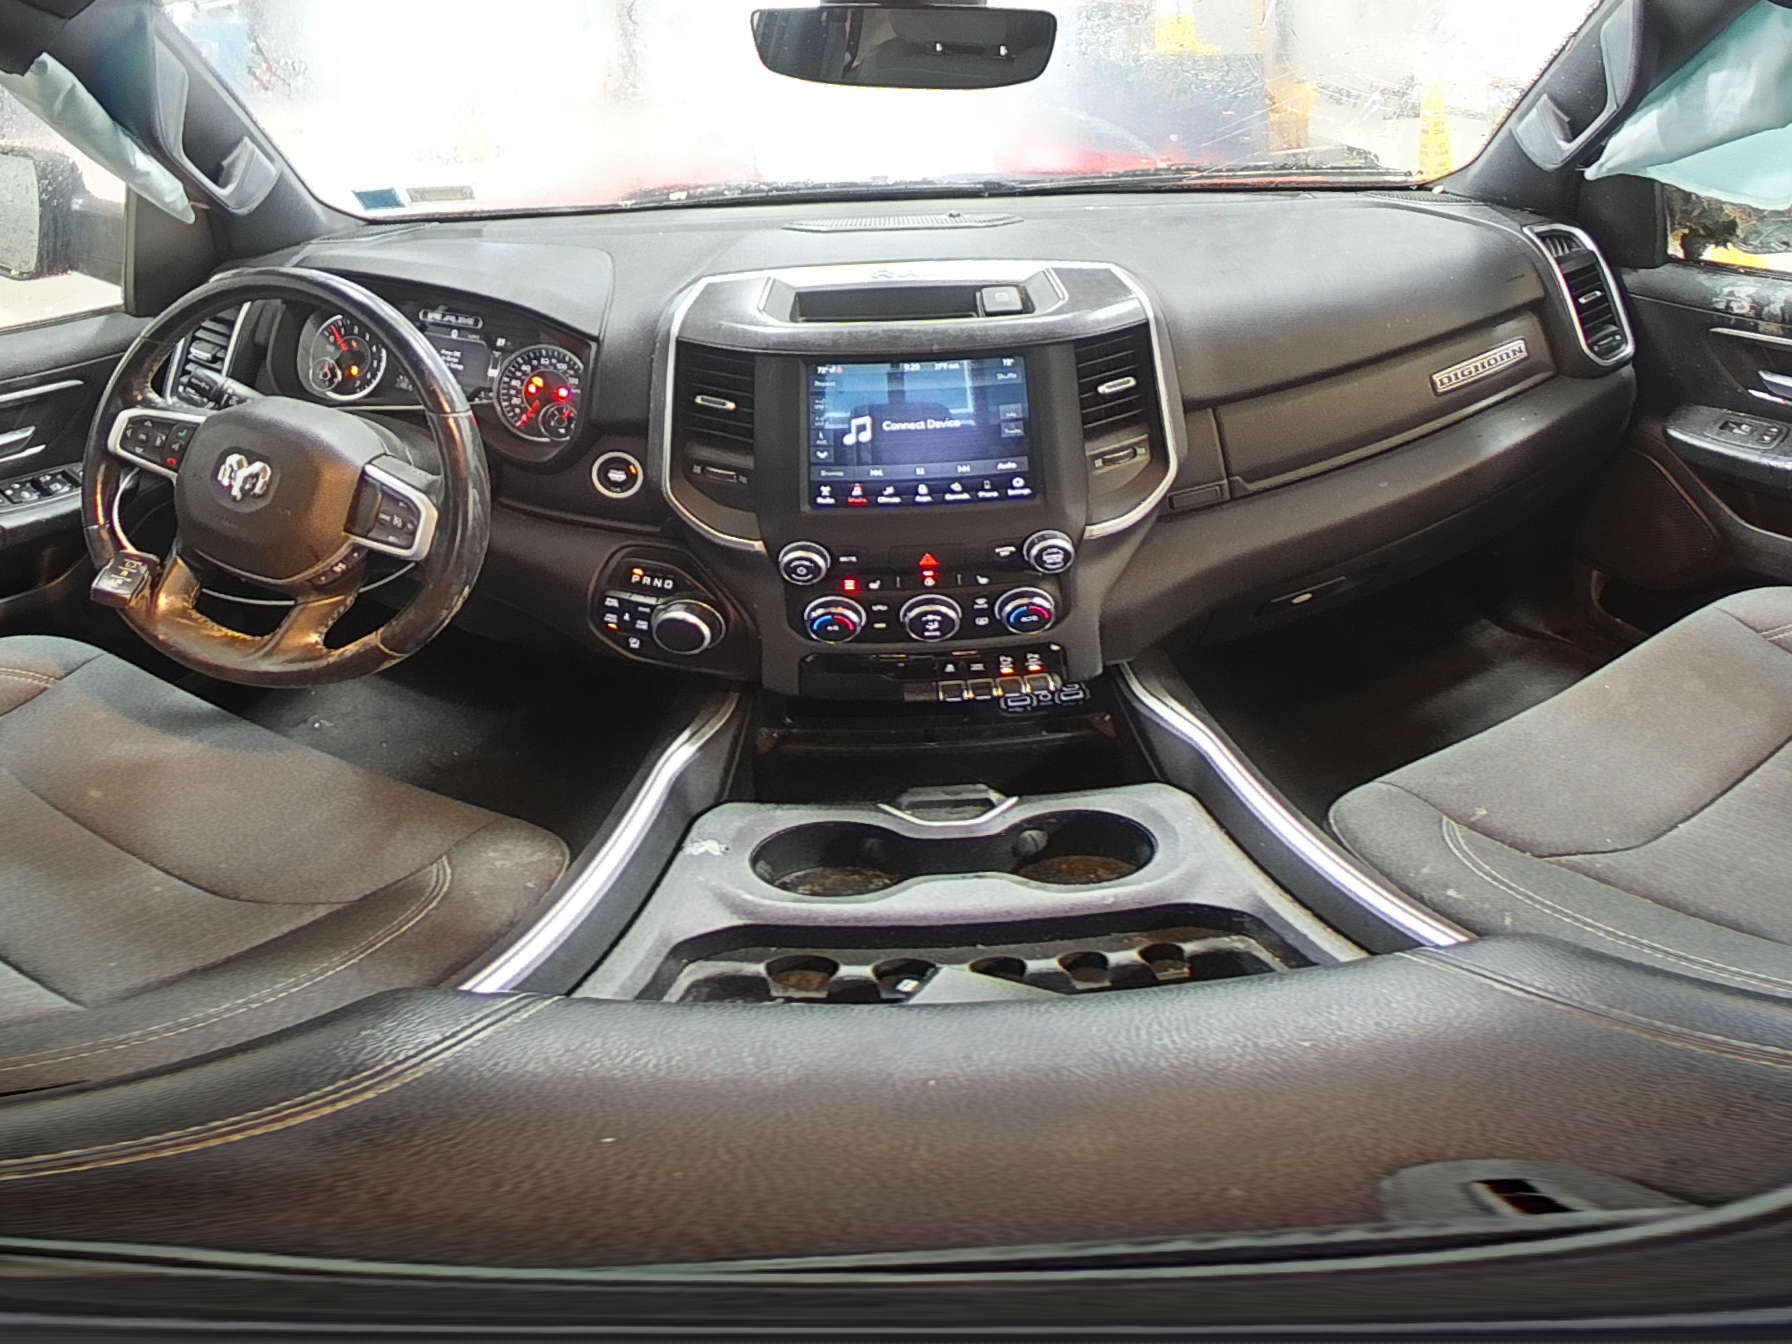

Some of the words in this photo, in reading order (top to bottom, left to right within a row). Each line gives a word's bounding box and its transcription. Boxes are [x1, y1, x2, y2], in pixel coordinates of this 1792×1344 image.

[427, 311, 475, 326] RAM
[882, 418, 925, 432] Connect
[927, 415, 962, 431] Device
